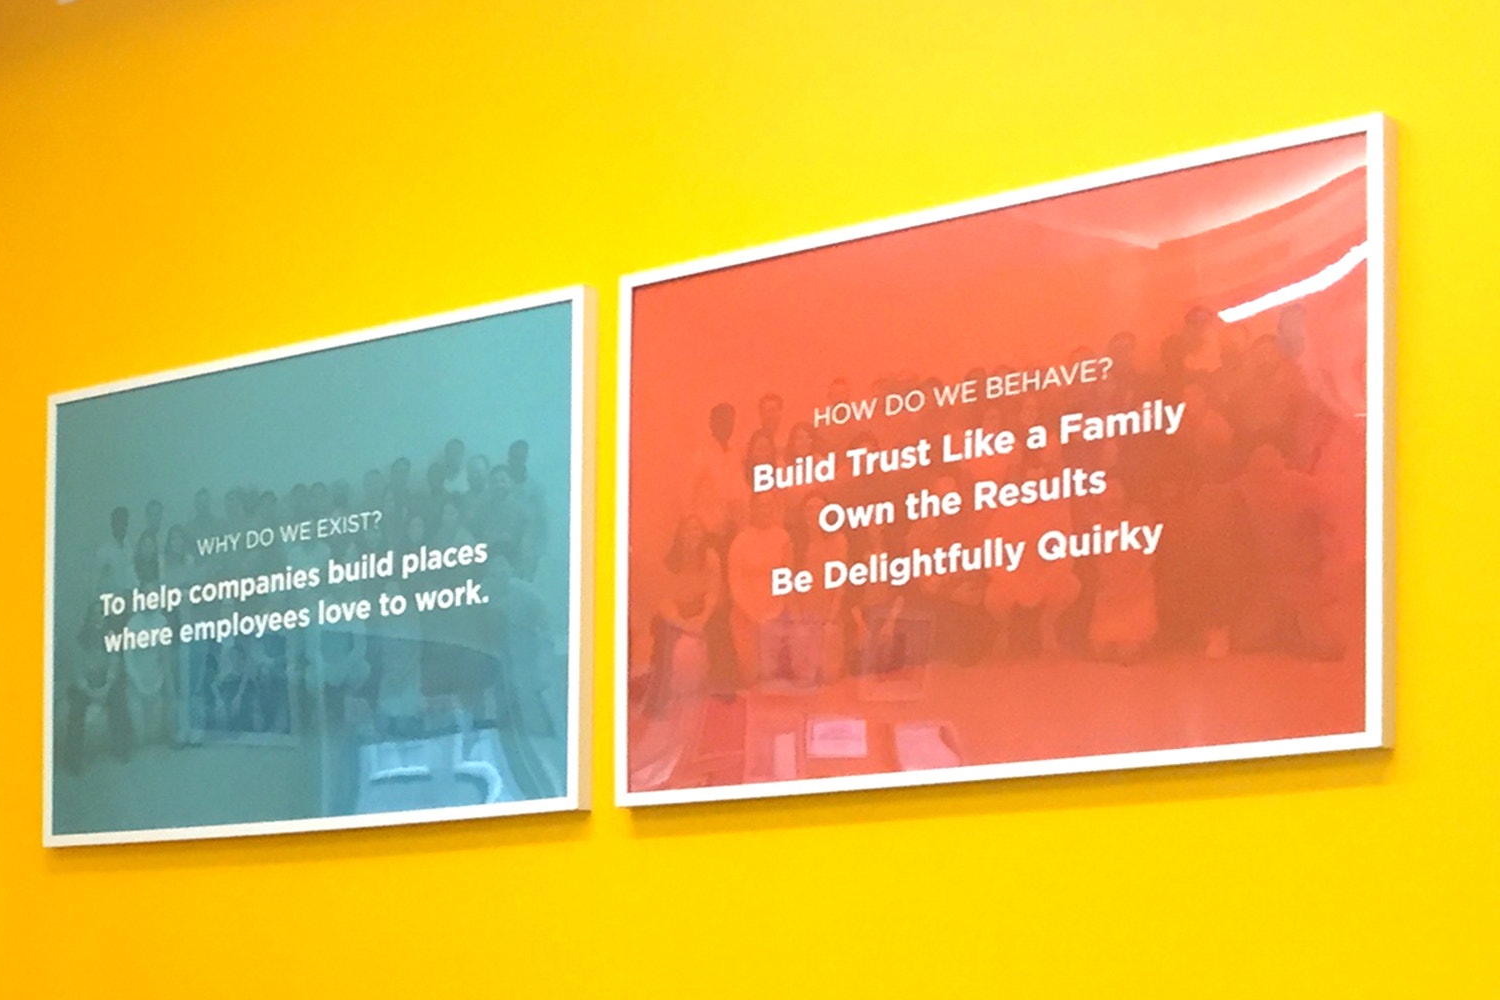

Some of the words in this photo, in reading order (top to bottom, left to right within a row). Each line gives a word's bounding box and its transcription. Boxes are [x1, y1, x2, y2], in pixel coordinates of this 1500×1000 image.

[814, 397, 877, 428] HOW
[885, 389, 925, 417] DO
[933, 380, 977, 407] WE
[986, 356, 1113, 399] BEHAVE?
[753, 452, 836, 493] Build
[846, 439, 931, 477] Trust
[943, 428, 1015, 463] Like
[1026, 425, 1047, 449] a
[1060, 399, 1186, 445] Family
[196, 532, 241, 557] WHY
[246, 527, 275, 549] DO
[279, 521, 312, 543] WE
[317, 510, 383, 538] EXIST?
[818, 501, 895, 532] Own
[905, 489, 962, 520] the
[974, 467, 1107, 511] Results
[99, 593, 126, 616] To
[132, 584, 182, 612] help
[189, 565, 321, 604] companies
[328, 550, 394, 584] build
[402, 543, 488, 579] places
[771, 567, 813, 596] Be
[824, 537, 1026, 590] Delightfully
[1037, 521, 1163, 561] Quirky
[104, 626, 173, 653] where
[179, 607, 311, 643] employees
[318, 599, 371, 625] love
[378, 592, 407, 617] to
[415, 579, 489, 612] work.
